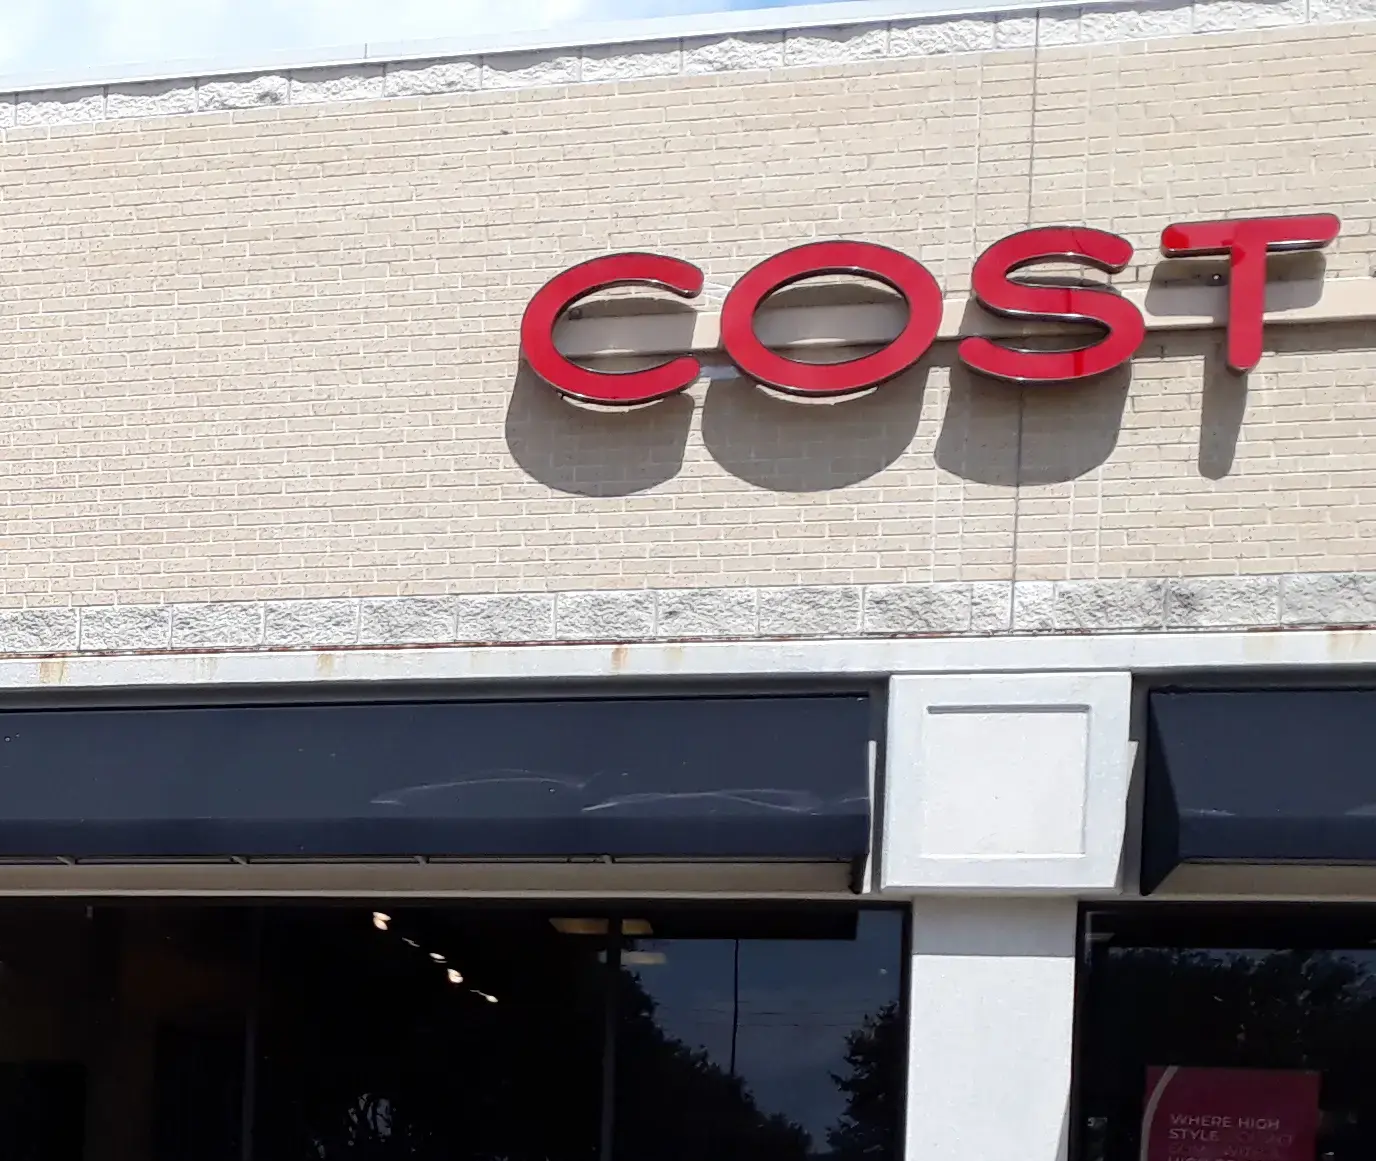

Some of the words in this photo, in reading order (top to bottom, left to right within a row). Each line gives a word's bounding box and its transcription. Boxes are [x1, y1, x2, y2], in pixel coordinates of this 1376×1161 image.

[519, 213, 1341, 402] COST
[1170, 1113, 1232, 1128] WHERE
[1238, 1117, 1280, 1131] HIGH
[1168, 1128, 1221, 1141] STYLE
